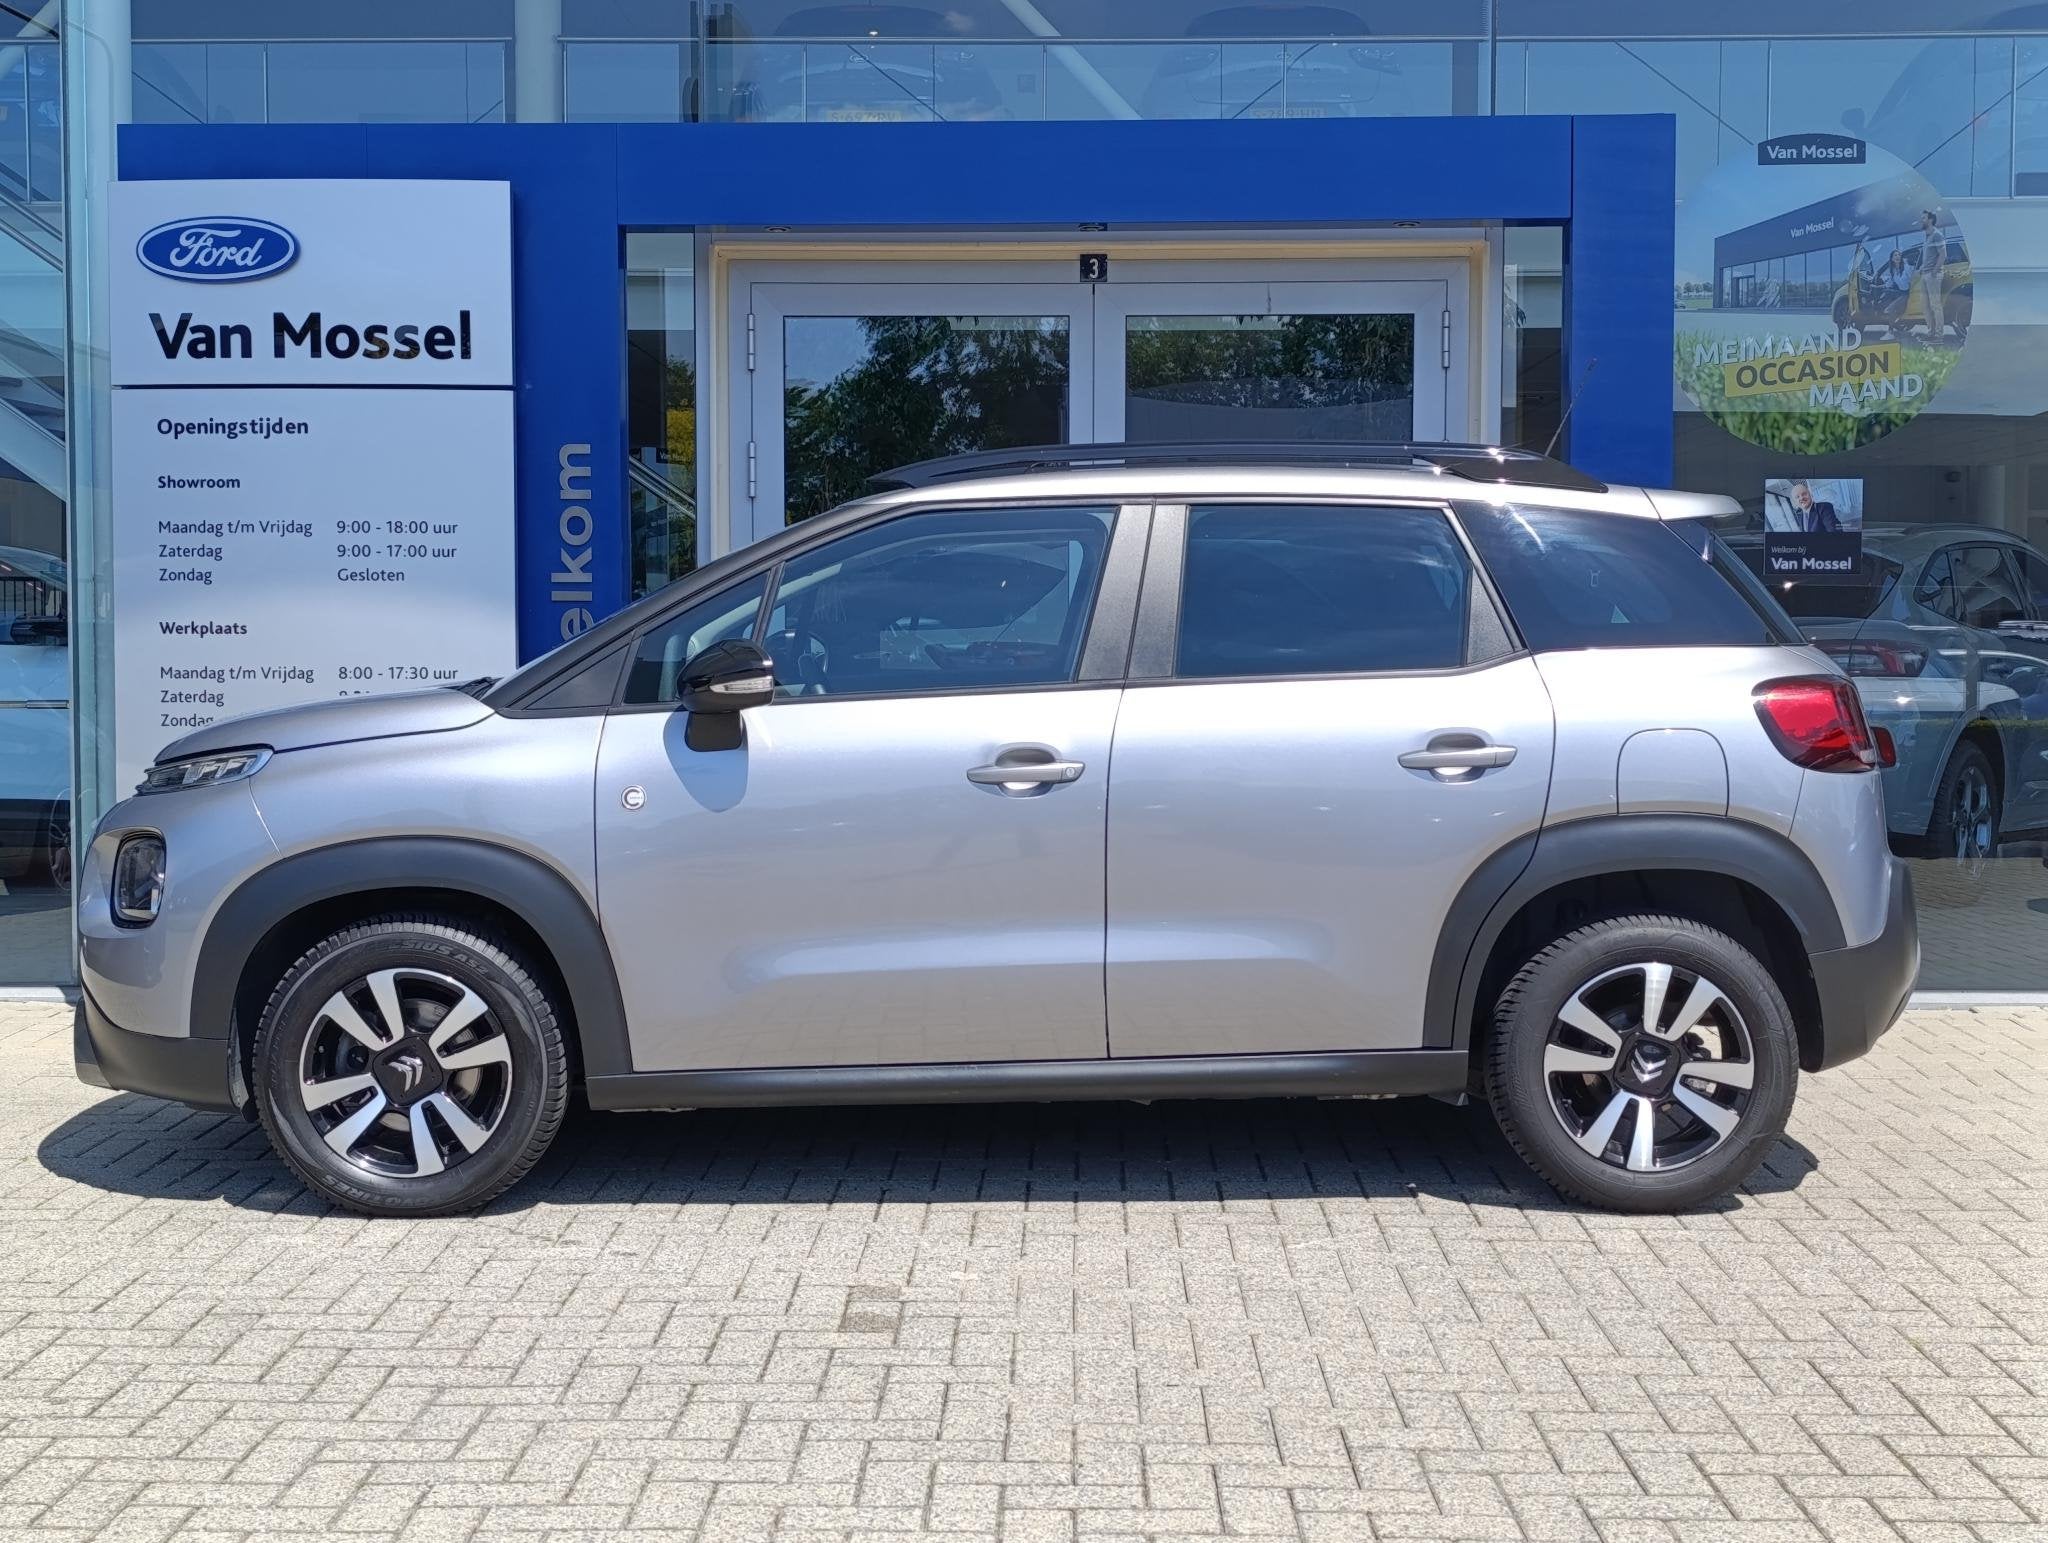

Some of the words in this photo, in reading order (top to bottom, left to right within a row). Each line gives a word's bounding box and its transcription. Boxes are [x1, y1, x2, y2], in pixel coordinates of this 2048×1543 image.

[1767, 145, 1797, 160] Van
[1802, 144, 1858, 159] Mossel
[1790, 227, 1805, 239] Van
[1806, 217, 1835, 234] Mossel
[169, 227, 264, 267] Ford
[1089, 258, 1099, 278] 3
[149, 313, 252, 359] Van
[274, 310, 471, 359] Mossel
[1695, 328, 1863, 367] MEIMAAND
[1735, 351, 1890, 389] OCCASION
[1808, 374, 1924, 408] MAAND
[158, 418, 308, 439] Openingstijden
[158, 475, 240, 488] Showroom
[159, 520, 223, 537] Maandag
[228, 520, 254, 533] t/m
[259, 520, 312, 537] Vrijdag
[337, 521, 370, 533] 9:00
[387, 521, 428, 533] 18:00
[434, 525, 457, 533] uur
[551, 442, 593, 641] elkom
[1771, 546, 1796, 554] Welkom
[159, 544, 222, 561] Zaterdag
[338, 545, 370, 557] 9:00
[387, 545, 427, 557] 17:00
[433, 549, 456, 557] uur
[1771, 557, 1798, 570] Van
[1802, 556, 1852, 570] Mossel
[160, 568, 212, 585] Zondag
[338, 568, 404, 581] Gesloten
[160, 621, 247, 638] Werkplaats
[161, 666, 225, 683] Maandag
[230, 666, 255, 679] t/m
[261, 666, 313, 683] Vrijdag
[339, 667, 372, 679] 8:00
[389, 667, 428, 679] 17:30
[434, 671, 457, 679] uur
[161, 690, 224, 707] Zaterdag
